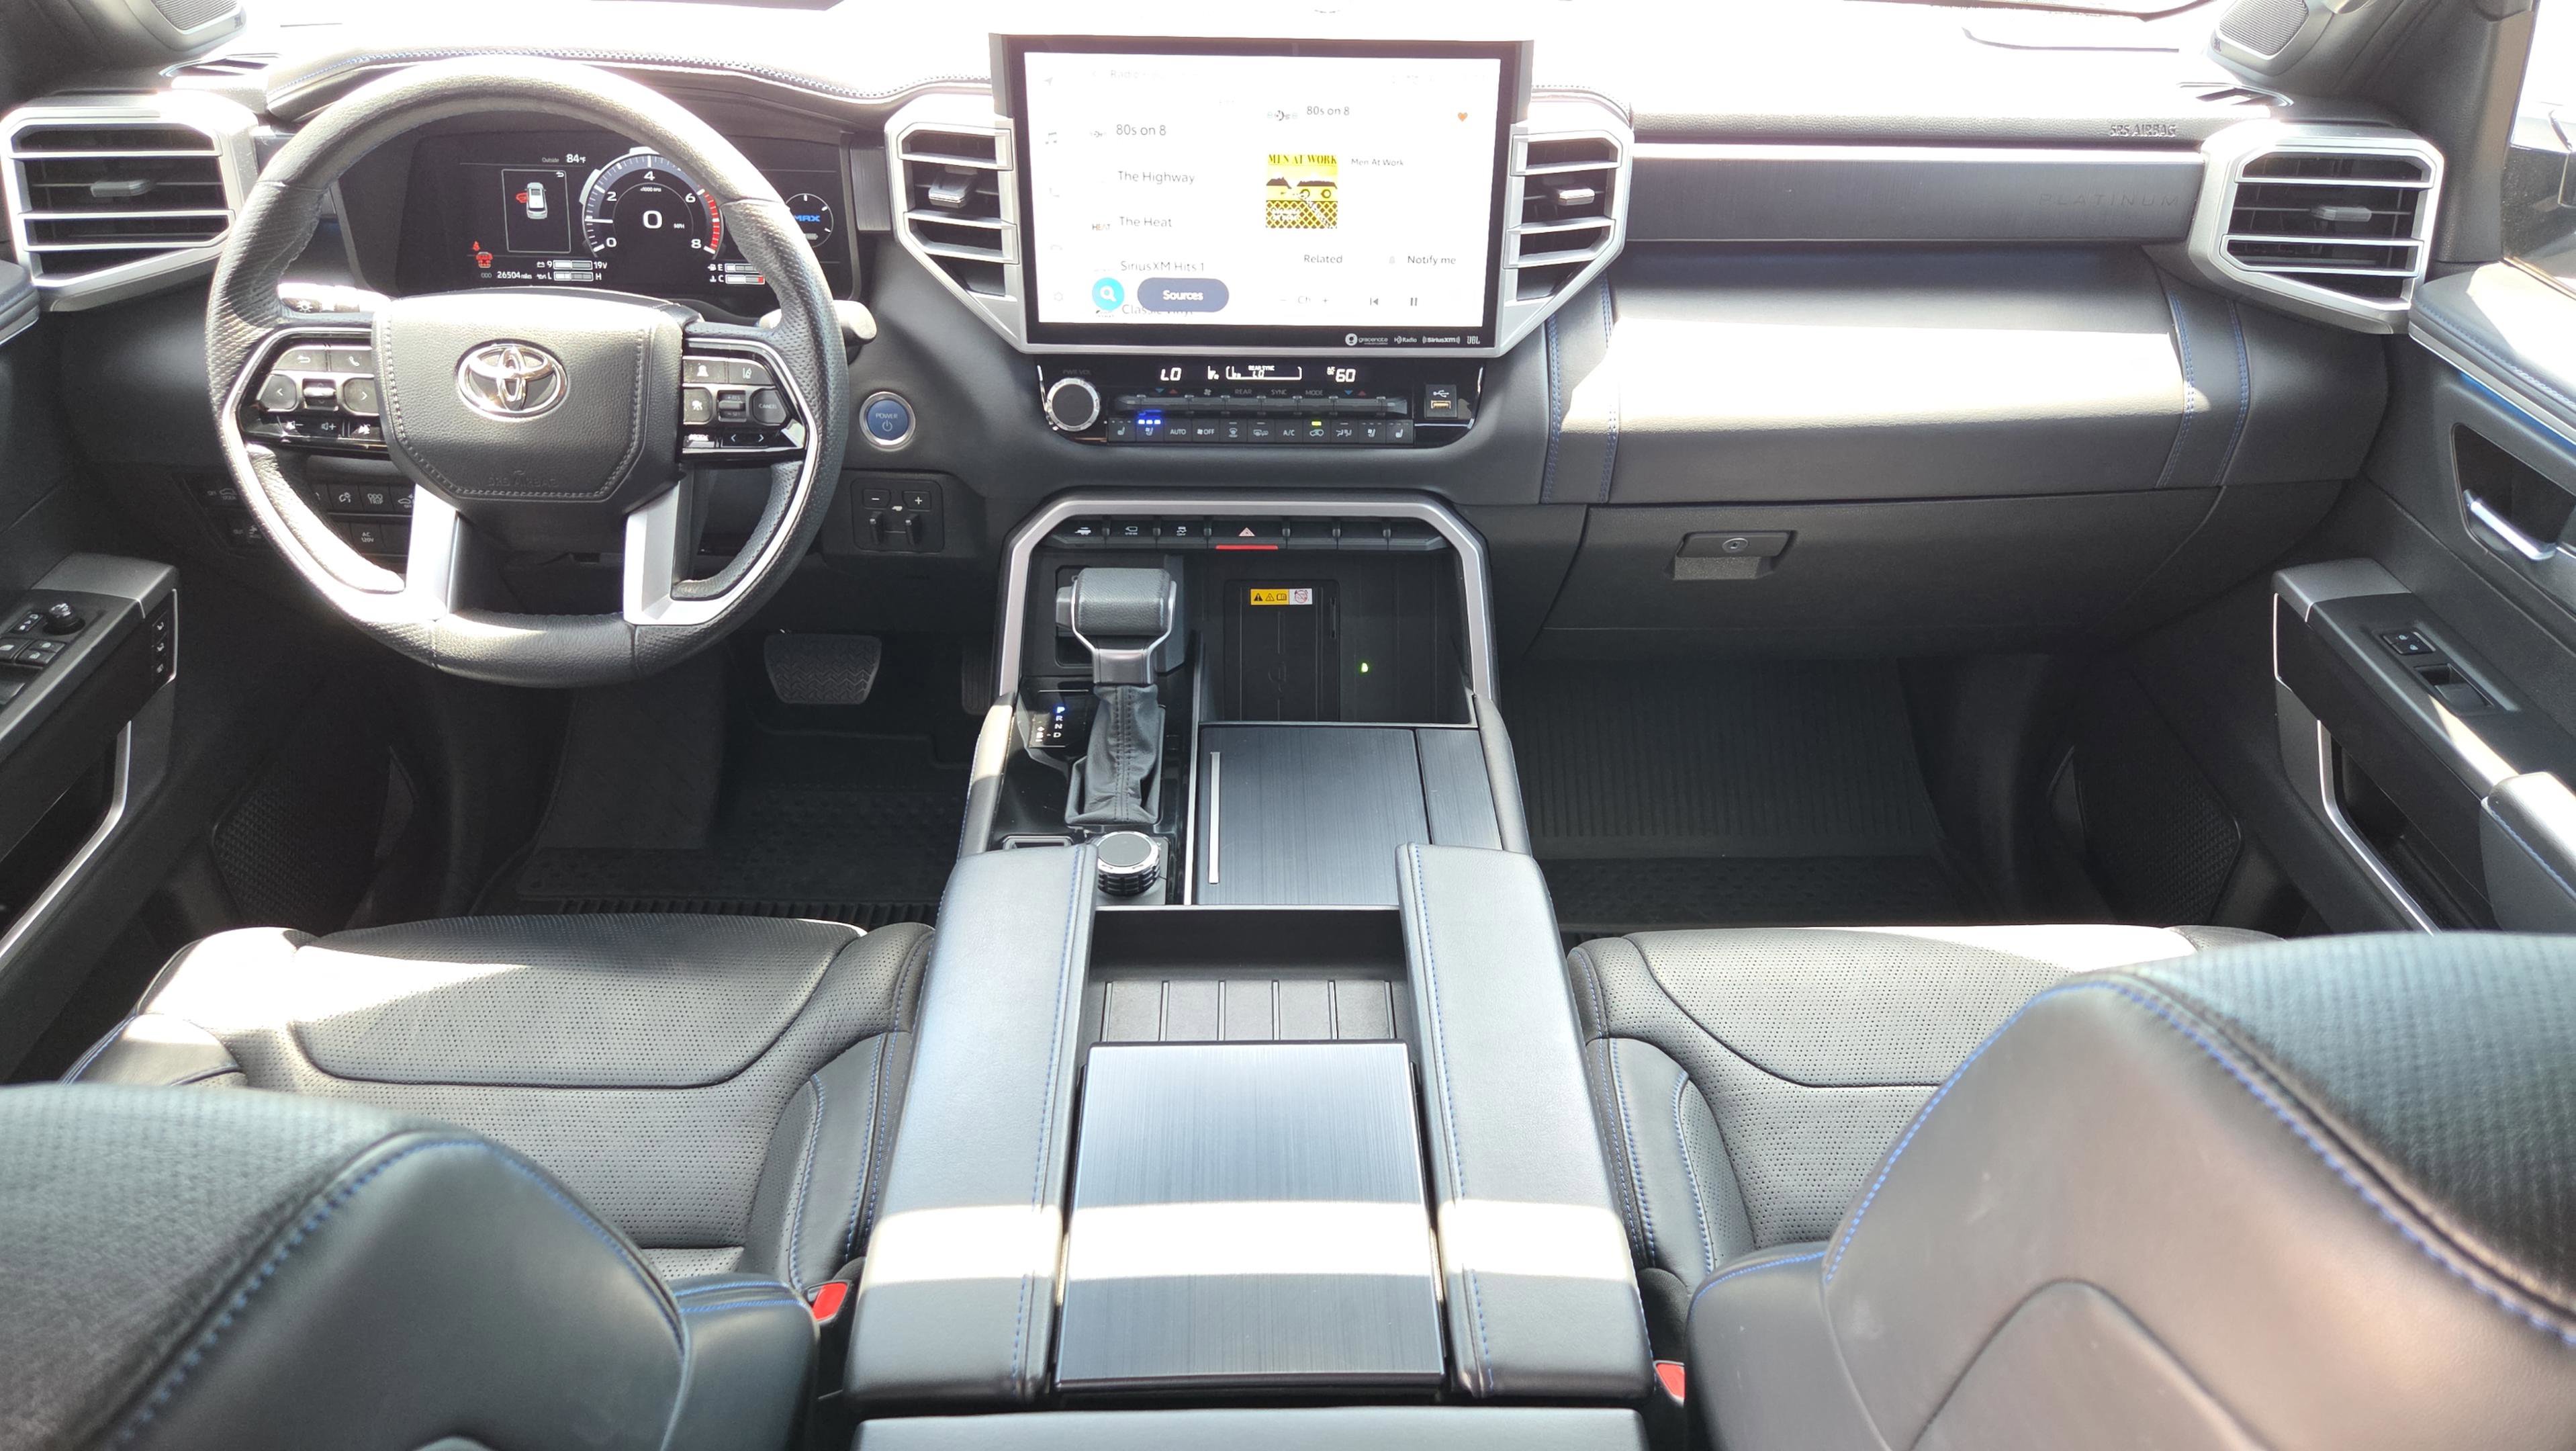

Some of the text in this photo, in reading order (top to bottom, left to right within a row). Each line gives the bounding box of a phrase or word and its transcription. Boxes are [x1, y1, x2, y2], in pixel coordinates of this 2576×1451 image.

[1306, 106, 1325, 116] 80s
[1343, 107, 1350, 116] 8
[1116, 124, 1137, 135] 80s
[1140, 127, 1156, 135] on
[1159, 125, 1166, 136] 8
[2110, 124, 2176, 138] SRS AIRBAG
[1269, 154, 1337, 165] MEN AT WORK
[643, 171, 655, 181] 4
[1118, 171, 1195, 185] The Highway
[606, 191, 617, 202] 2
[685, 193, 696, 203] 6
[2039, 193, 2178, 206] PLATINUM
[643, 210, 663, 229] 0
[794, 214, 821, 222] MAX
[1119, 216, 1172, 228] The Heat
[606, 237, 617, 248] 0
[690, 238, 702, 249] 8
[1304, 255, 1343, 263] Related
[1408, 256, 1438, 265] Notify
[717, 263, 723, 271] E
[1120, 261, 1205, 271] SiriusXM Hits 1
[1162, 290, 1204, 301] Sources
[1467, 336, 1480, 345] JBL
[1160, 367, 1182, 381] LO
[1335, 368, 1356, 382] 60
